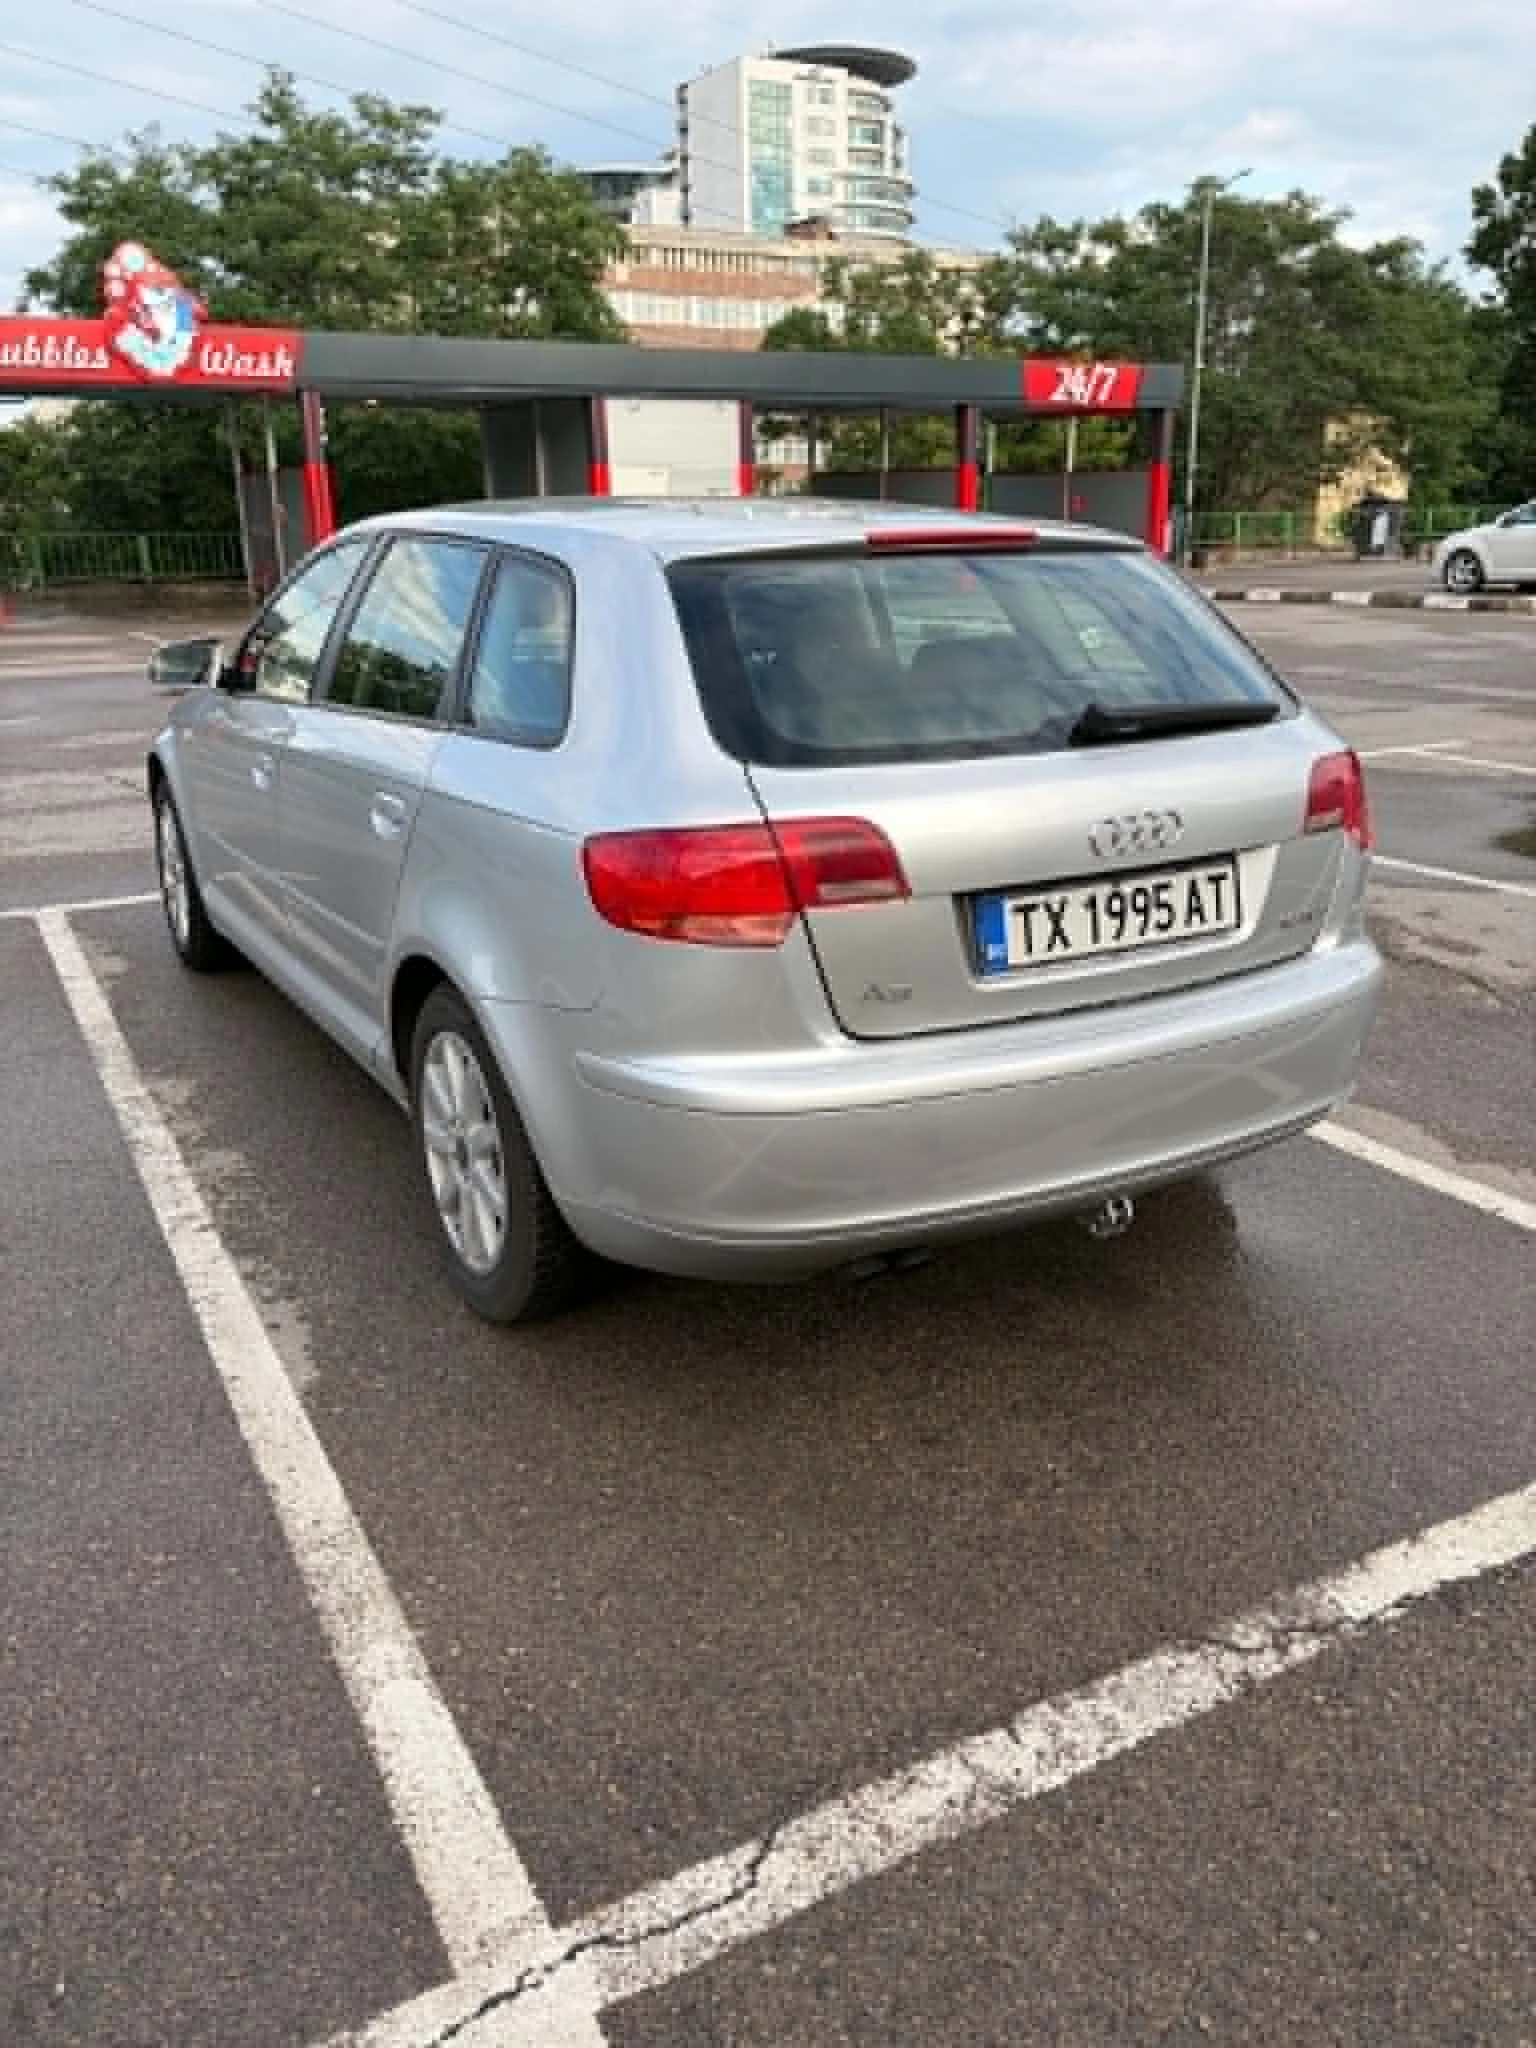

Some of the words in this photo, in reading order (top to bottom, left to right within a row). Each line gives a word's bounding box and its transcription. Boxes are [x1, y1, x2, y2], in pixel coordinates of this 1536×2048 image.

[0, 334, 111, 369] ubbles
[199, 340, 295, 377] Wash
[1048, 362, 1119, 406] 24/7
[1011, 894, 1071, 955] TX
[1085, 881, 1175, 945] 1995
[1184, 870, 1229, 928] AT
